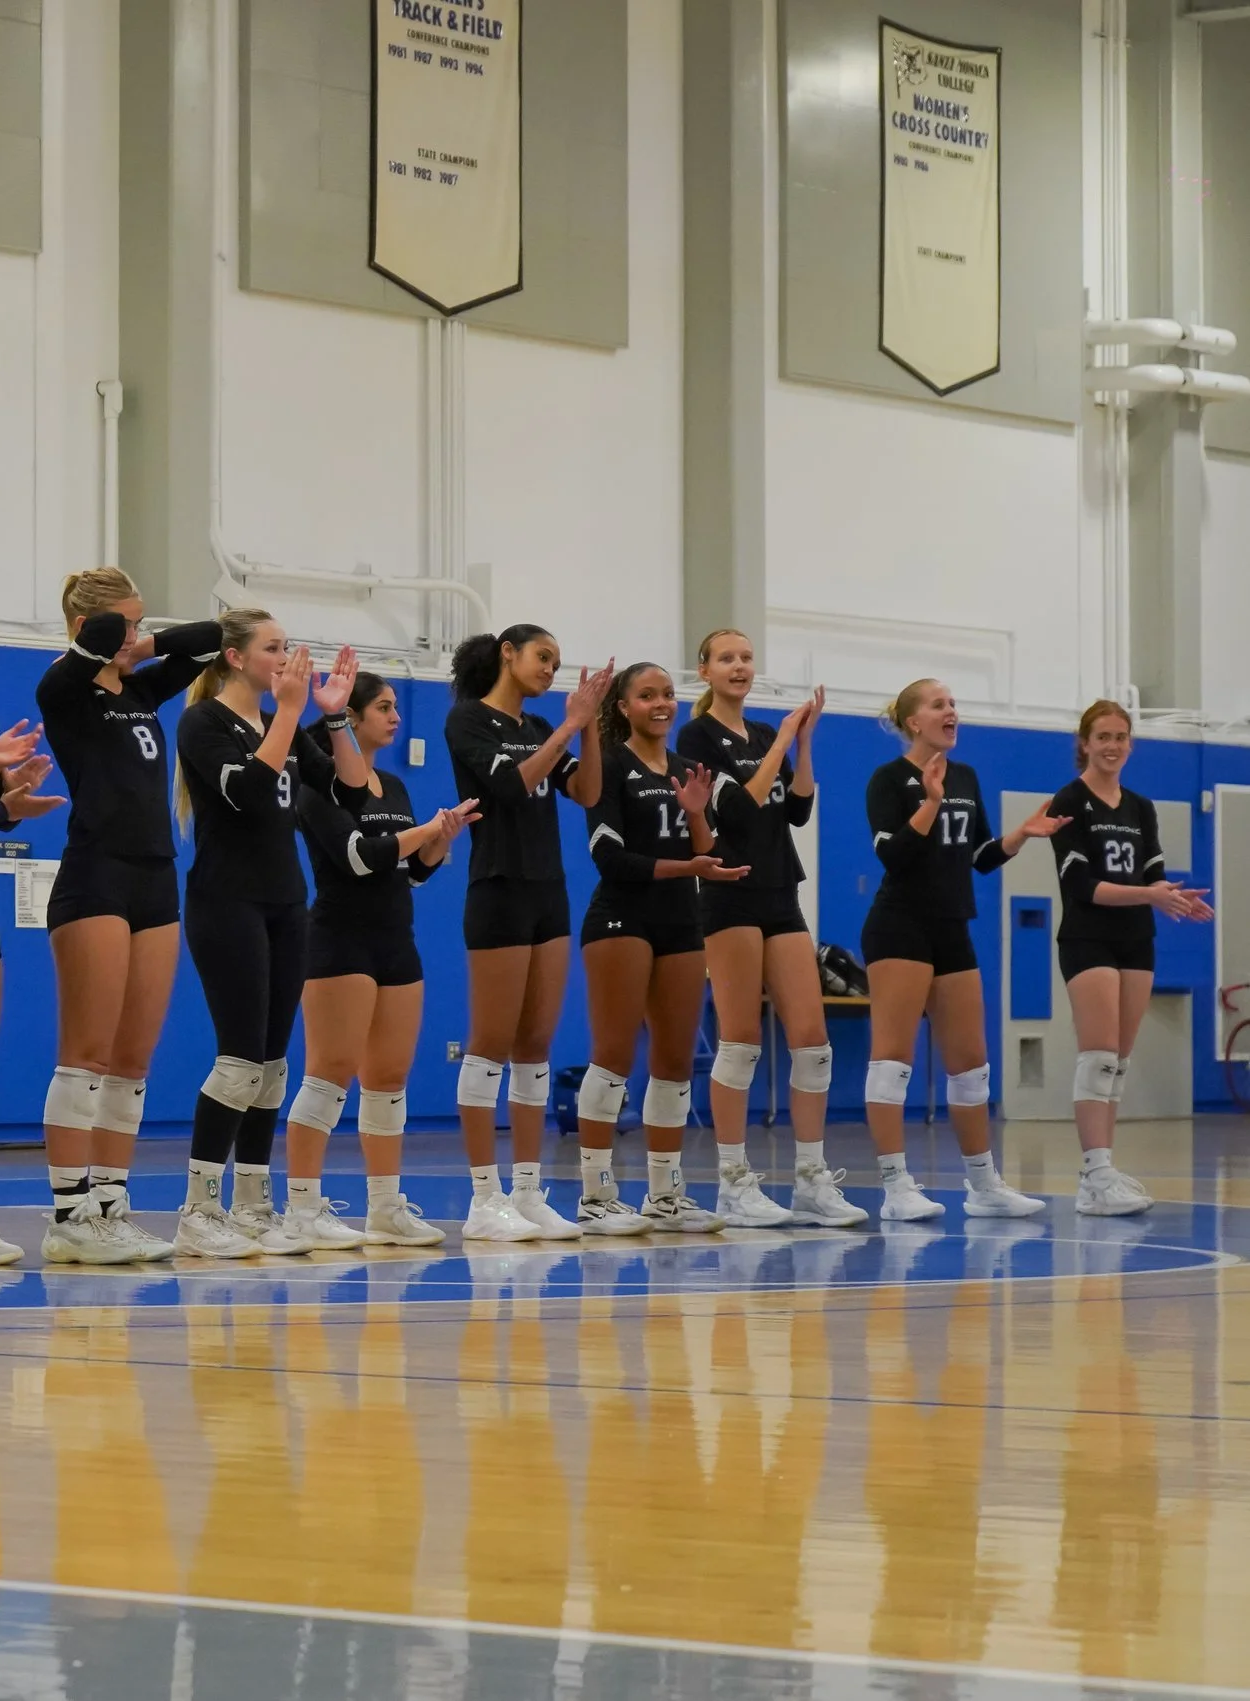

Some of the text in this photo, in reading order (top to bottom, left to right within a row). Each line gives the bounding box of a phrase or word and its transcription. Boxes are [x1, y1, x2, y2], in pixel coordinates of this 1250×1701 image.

[393, 0, 503, 40] TRACK & FIELD
[406, 29, 490, 56] CONFERENCE CHAMPIONS
[388, 44, 407, 59] 1981
[440, 56, 458, 71] 1993
[938, 73, 974, 94] COLLEGE
[913, 92, 969, 122] WOMEN'S
[892, 110, 989, 149] CROSS COUNTRY
[417, 148, 478, 168] STATE CHAMPIONS
[389, 160, 459, 186] 1981 1982 1987
[132, 725, 158, 759] 8
[277, 770, 291, 807] 9
[638, 788, 668, 797] SANTA
[361, 813, 390, 822] SANTA
[659, 803, 690, 838] 14
[941, 811, 969, 844] 17
[1090, 824, 1116, 832] SANTA
[1105, 840, 1134, 873] 23
